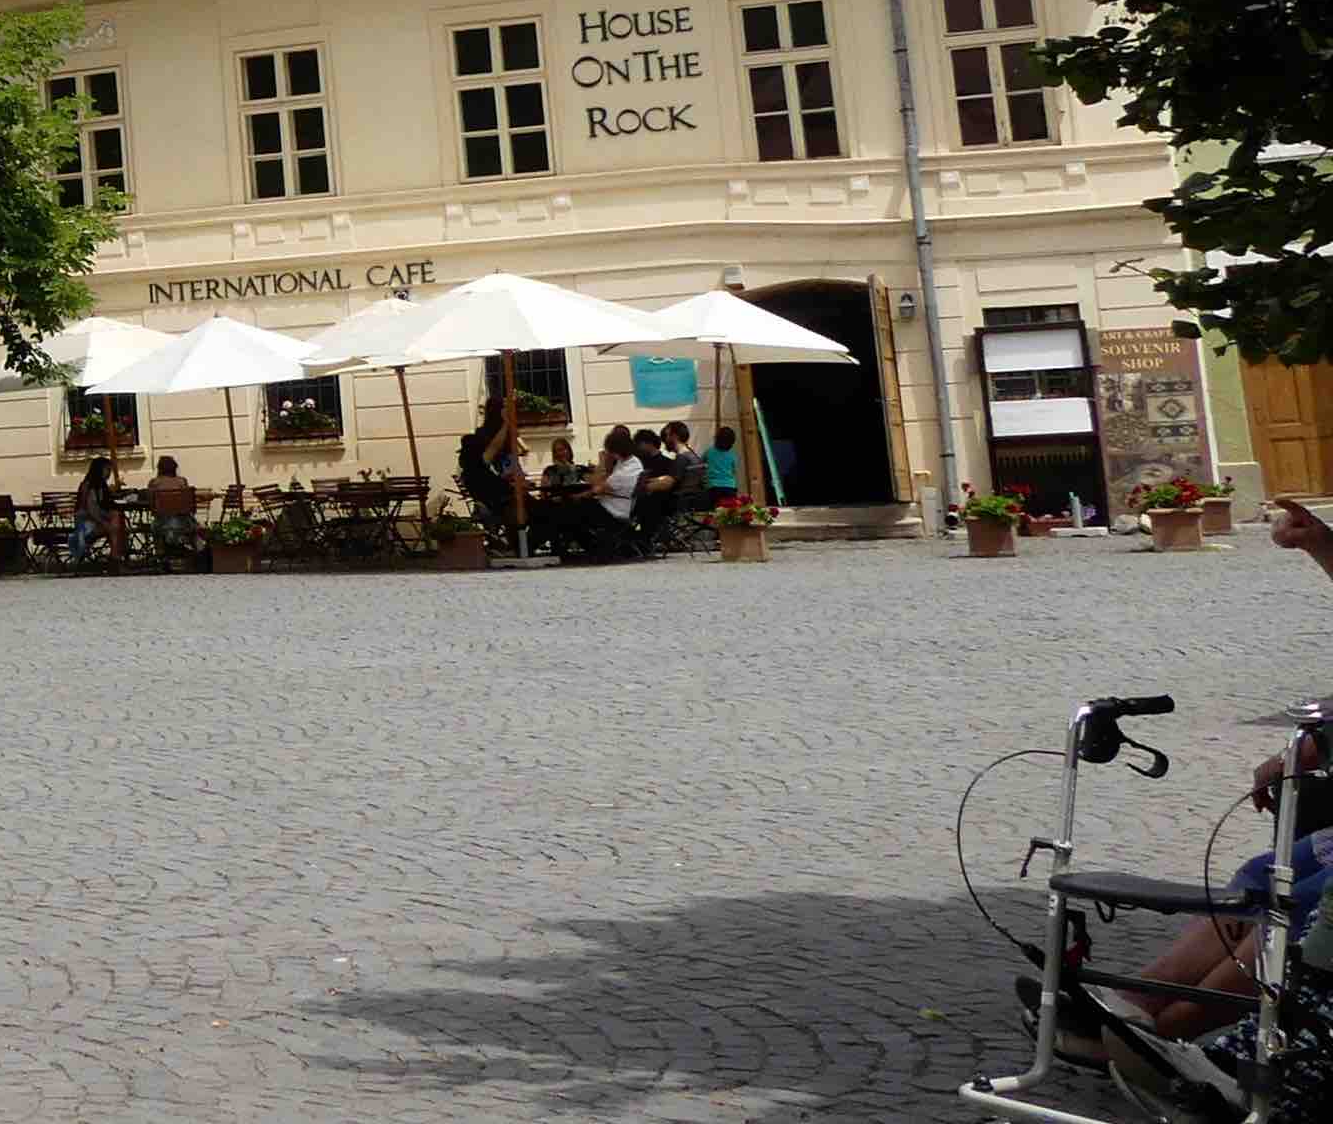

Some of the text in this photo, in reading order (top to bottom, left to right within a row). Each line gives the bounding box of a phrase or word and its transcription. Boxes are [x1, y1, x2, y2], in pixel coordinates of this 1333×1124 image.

[578, 7, 694, 44] HOUSE
[586, 104, 697, 138] ROCK
[149, 268, 351, 304] INTERNATIONAL
[1100, 341, 1181, 356] SOUVENIR
[1121, 357, 1164, 370] SHOP
